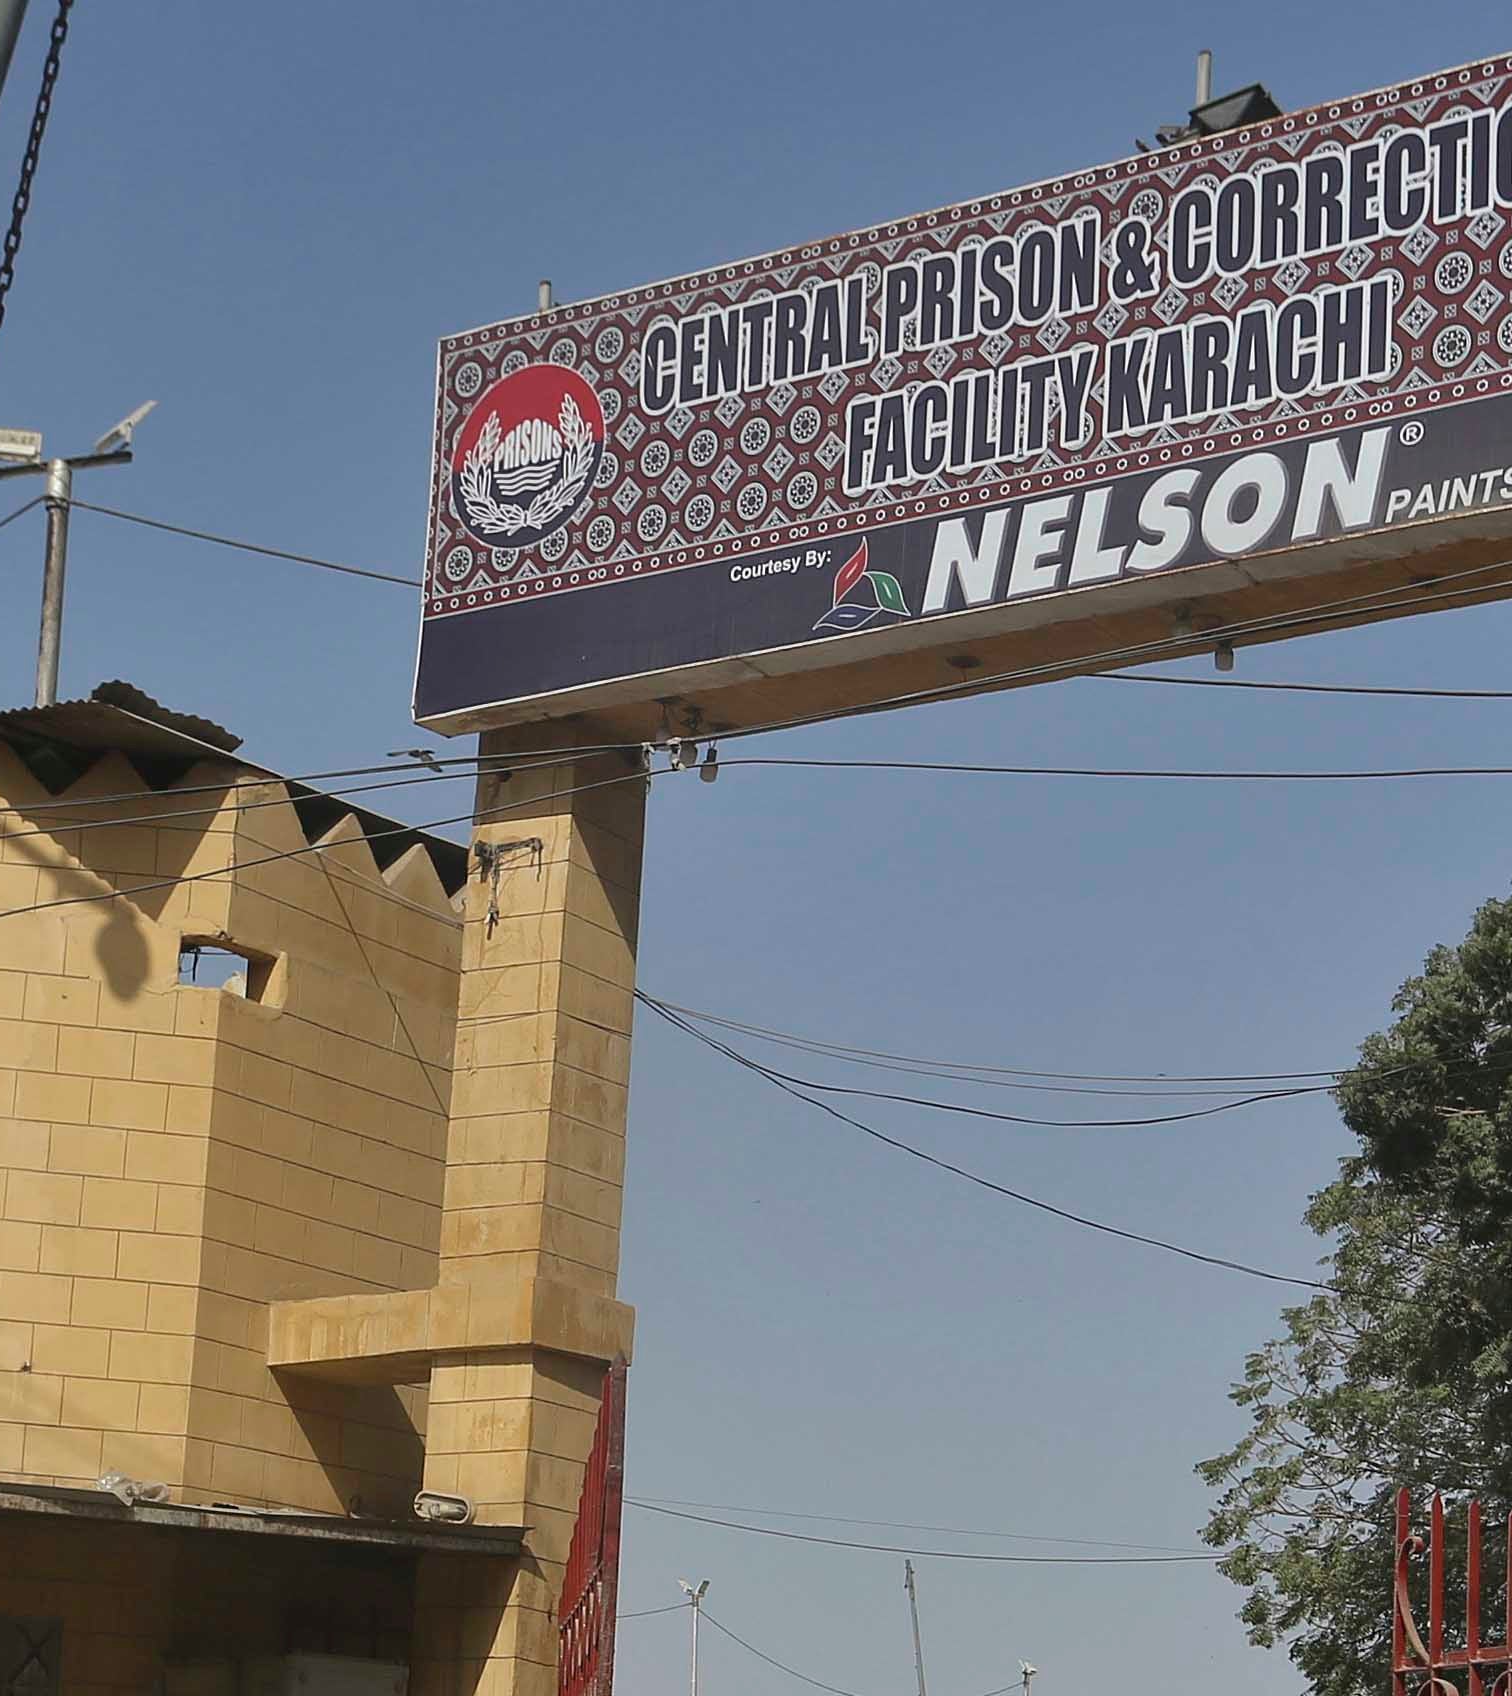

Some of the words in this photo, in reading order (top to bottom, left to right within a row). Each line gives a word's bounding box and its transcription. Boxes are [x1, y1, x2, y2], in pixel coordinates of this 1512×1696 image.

[640, 272, 874, 417] CENTRAL
[881, 207, 1101, 361] PRISON
[1109, 218, 1161, 305] &
[843, 347, 1098, 498] FACILITY
[1102, 275, 1396, 438] KARACHI
[493, 418, 564, 472] PRISONS
[922, 425, 1393, 616] NELSON
[730, 556, 801, 582] Courtesy
[805, 550, 833, 570] By:
